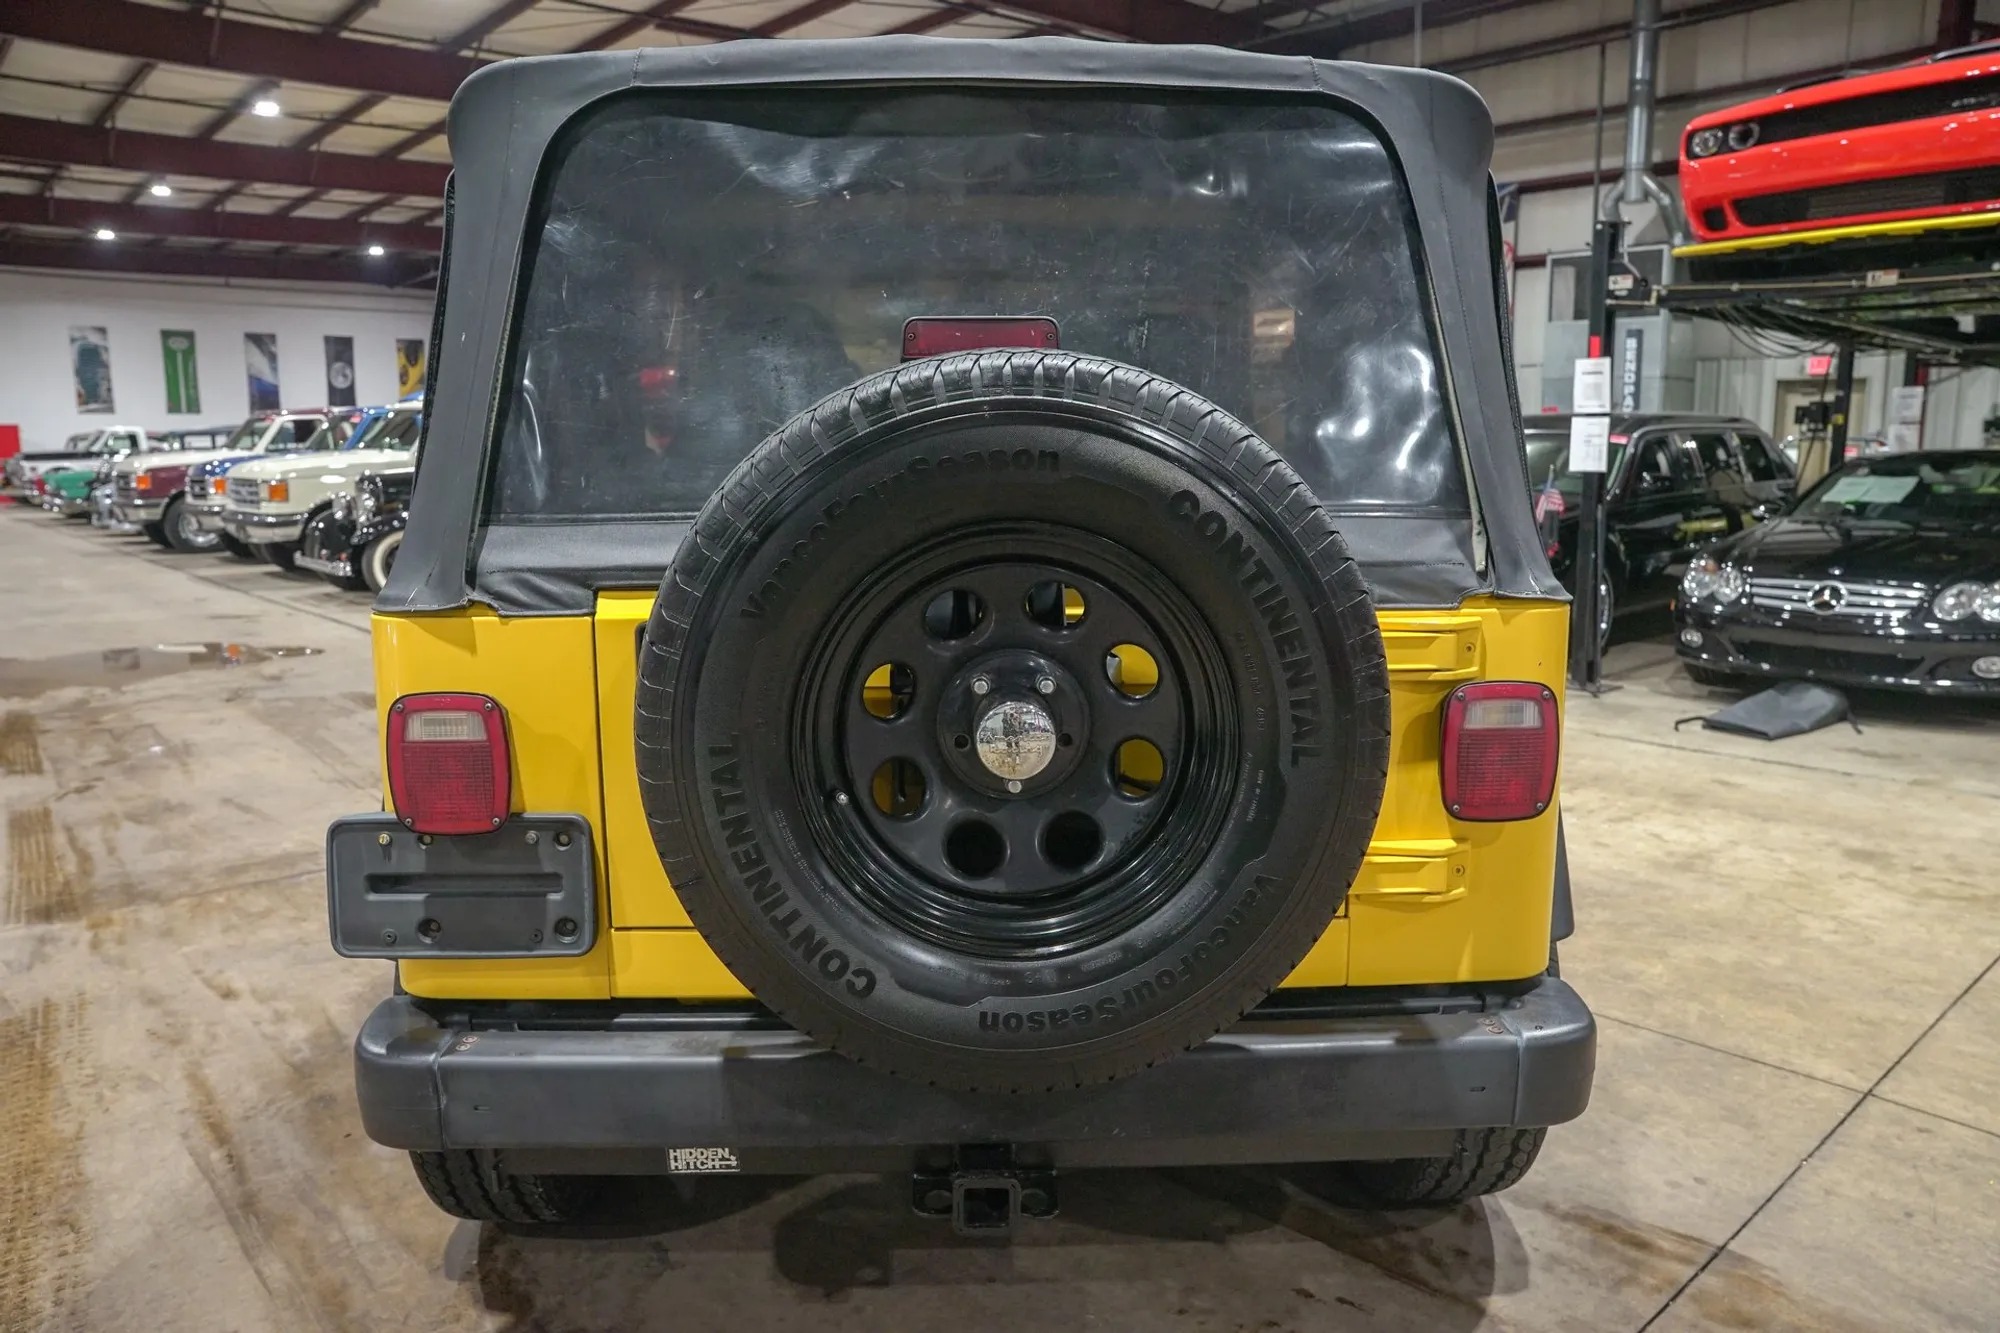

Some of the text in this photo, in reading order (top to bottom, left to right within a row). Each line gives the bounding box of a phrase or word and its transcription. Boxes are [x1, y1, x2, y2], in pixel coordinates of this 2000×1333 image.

[1622, 337, 1638, 412] BENDPA
[1170, 489, 1325, 767] CONTINENTAL
[708, 733, 877, 1001] CONTINENTAL
[668, 1147, 730, 1160] HIDDEN
[670, 1158, 721, 1170] HITCH
